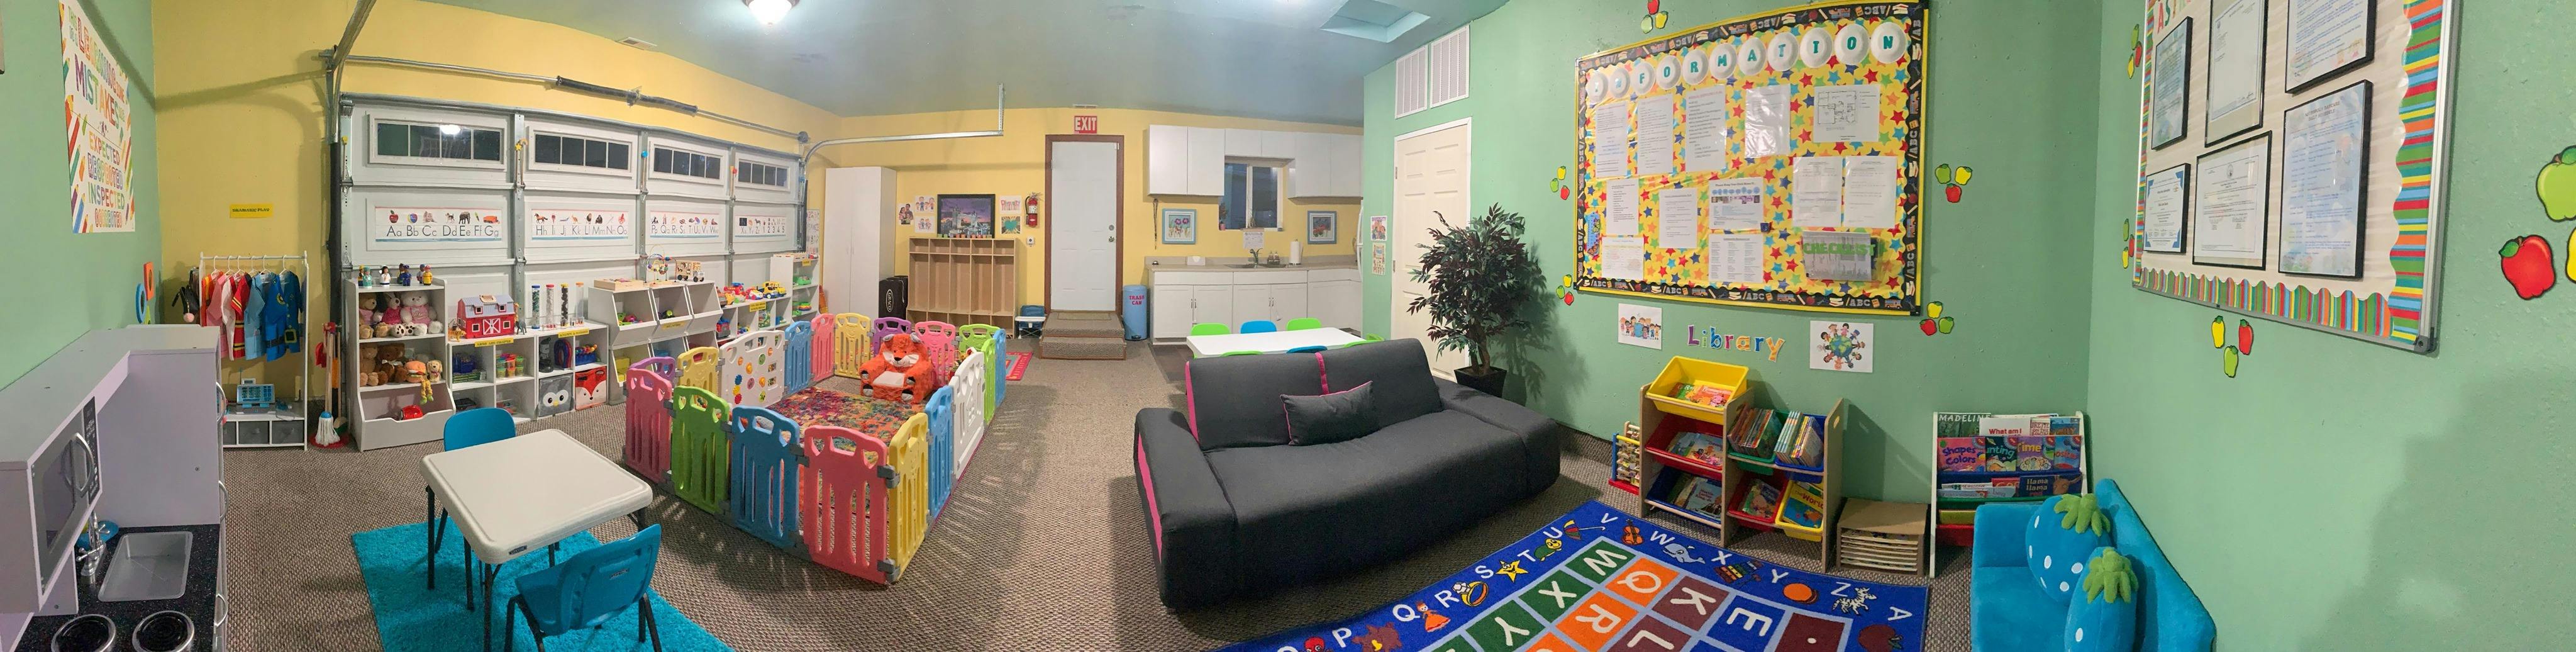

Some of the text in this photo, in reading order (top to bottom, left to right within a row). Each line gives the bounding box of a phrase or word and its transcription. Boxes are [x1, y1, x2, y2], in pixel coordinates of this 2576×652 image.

[77, 17, 116, 93] LEARNING
[74, 53, 119, 129] MISTAKES
[1075, 117, 1097, 131] EXIT
[89, 131, 120, 166] EXPECTED
[87, 152, 123, 189] RESPECTED
[88, 182, 125, 210] INSPECTED
[95, 208, 123, 228] CORRECTED
[386, 225, 499, 238] Aa Bb Cc Dd Ee Ff Gg
[1803, 242, 1875, 256] CHECKLIST
[1746, 292, 1765, 300] ABC
[1688, 325, 1785, 363] Library
[1942, 447, 1975, 456] Shapes
[1946, 455, 1975, 464] Colors
[1601, 513, 1852, 597] V W X Y Z
[1332, 527, 1563, 648] P Q R S T U
[1575, 571, 1662, 633] R Q
[1626, 587, 1716, 649] L K
[1726, 607, 1773, 637] E
[1888, 606, 1913, 621] A
